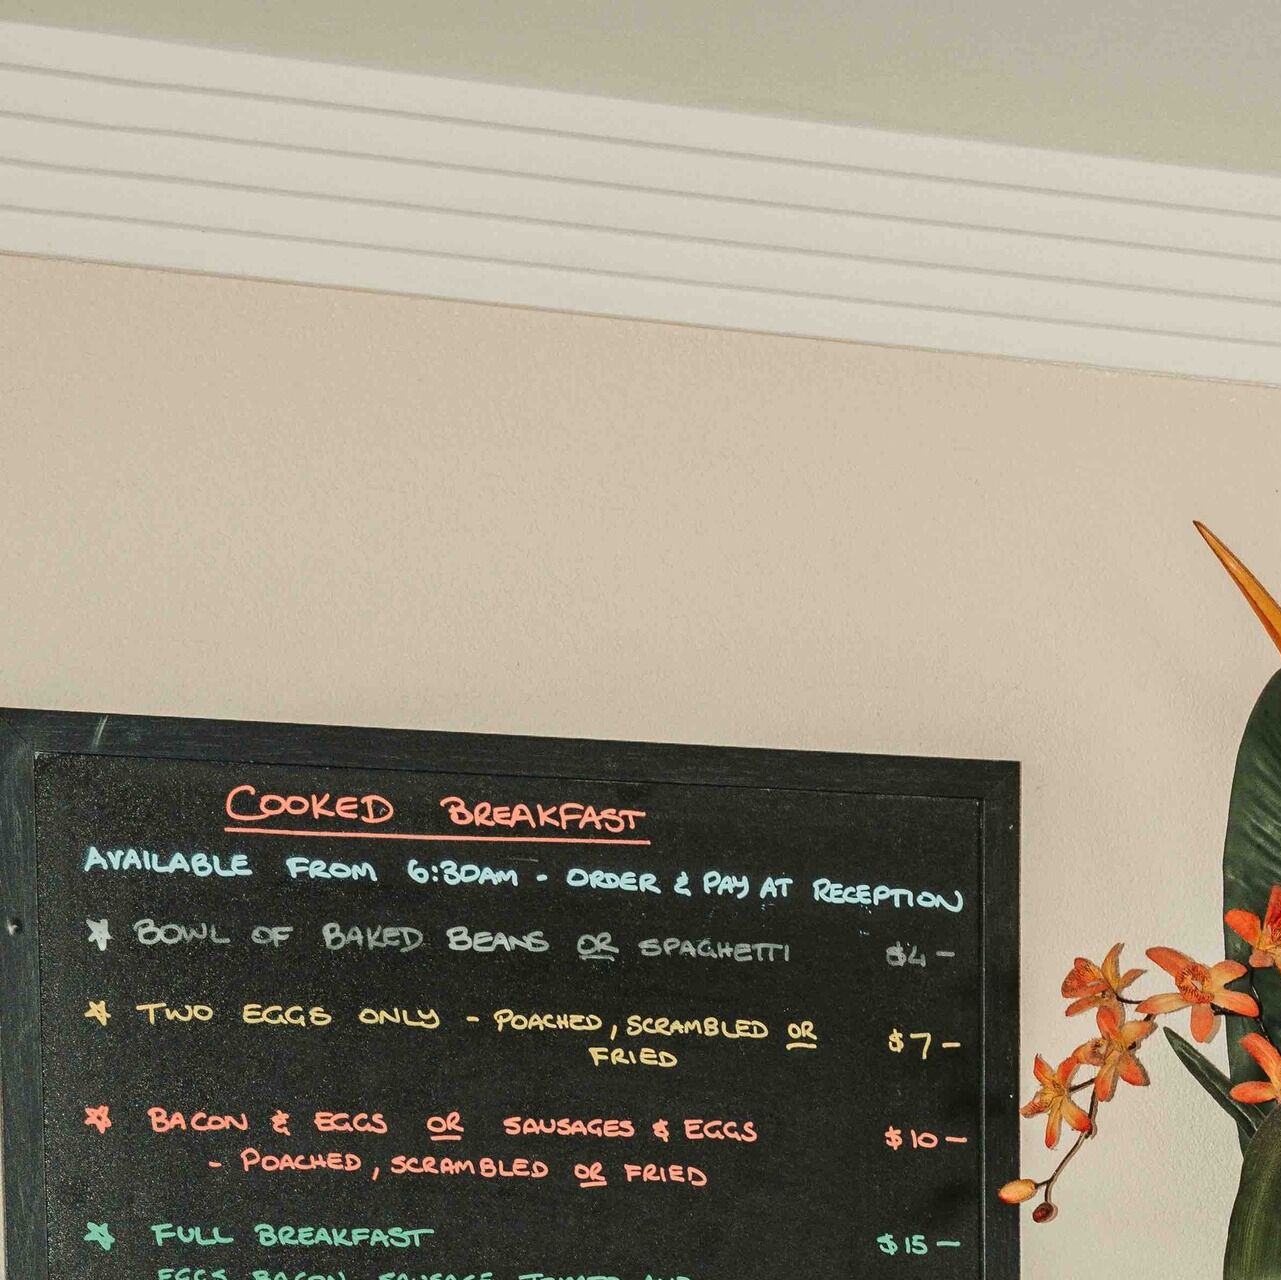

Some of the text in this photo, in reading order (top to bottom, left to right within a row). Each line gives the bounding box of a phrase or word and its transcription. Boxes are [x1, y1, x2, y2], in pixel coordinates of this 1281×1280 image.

[225, 784, 646, 833] COOKED BREAKFAST
[83, 846, 253, 877] AVAILABLE
[285, 857, 378, 881] FROM
[407, 859, 518, 886] 6:30AM
[566, 868, 661, 894] ORDER
[703, 870, 749, 899] PAY
[759, 877, 793, 899] AT
[812, 878, 963, 913] RECEPTION
[133, 918, 230, 945] BOWL
[252, 926, 293, 947] OF
[322, 923, 423, 952] BAKED
[446, 926, 549, 952] BEANS
[577, 932, 619, 958] OR
[638, 938, 789, 961] SPAGHETTI
[136, 1002, 214, 1025] TWO
[242, 1003, 332, 1027] EGGS
[358, 1007, 440, 1029] ONLY
[626, 1015, 768, 1038] SCRAMBLED
[788, 1021, 817, 1040] OR
[588, 1047, 678, 1067] FRIED
[147, 1106, 248, 1133] BACON
[313, 1111, 388, 1134] EGGS
[426, 1111, 464, 1133] OR
[503, 1116, 635, 1137] SAUSAGES
[683, 1119, 758, 1142] EGGS
[390, 1155, 549, 1178] SCRAMBLED
[574, 1161, 607, 1185] OR
[624, 1163, 707, 1187] FRIED
[150, 1223, 234, 1246] FULL
[254, 1223, 434, 1247] BREAKFAST
